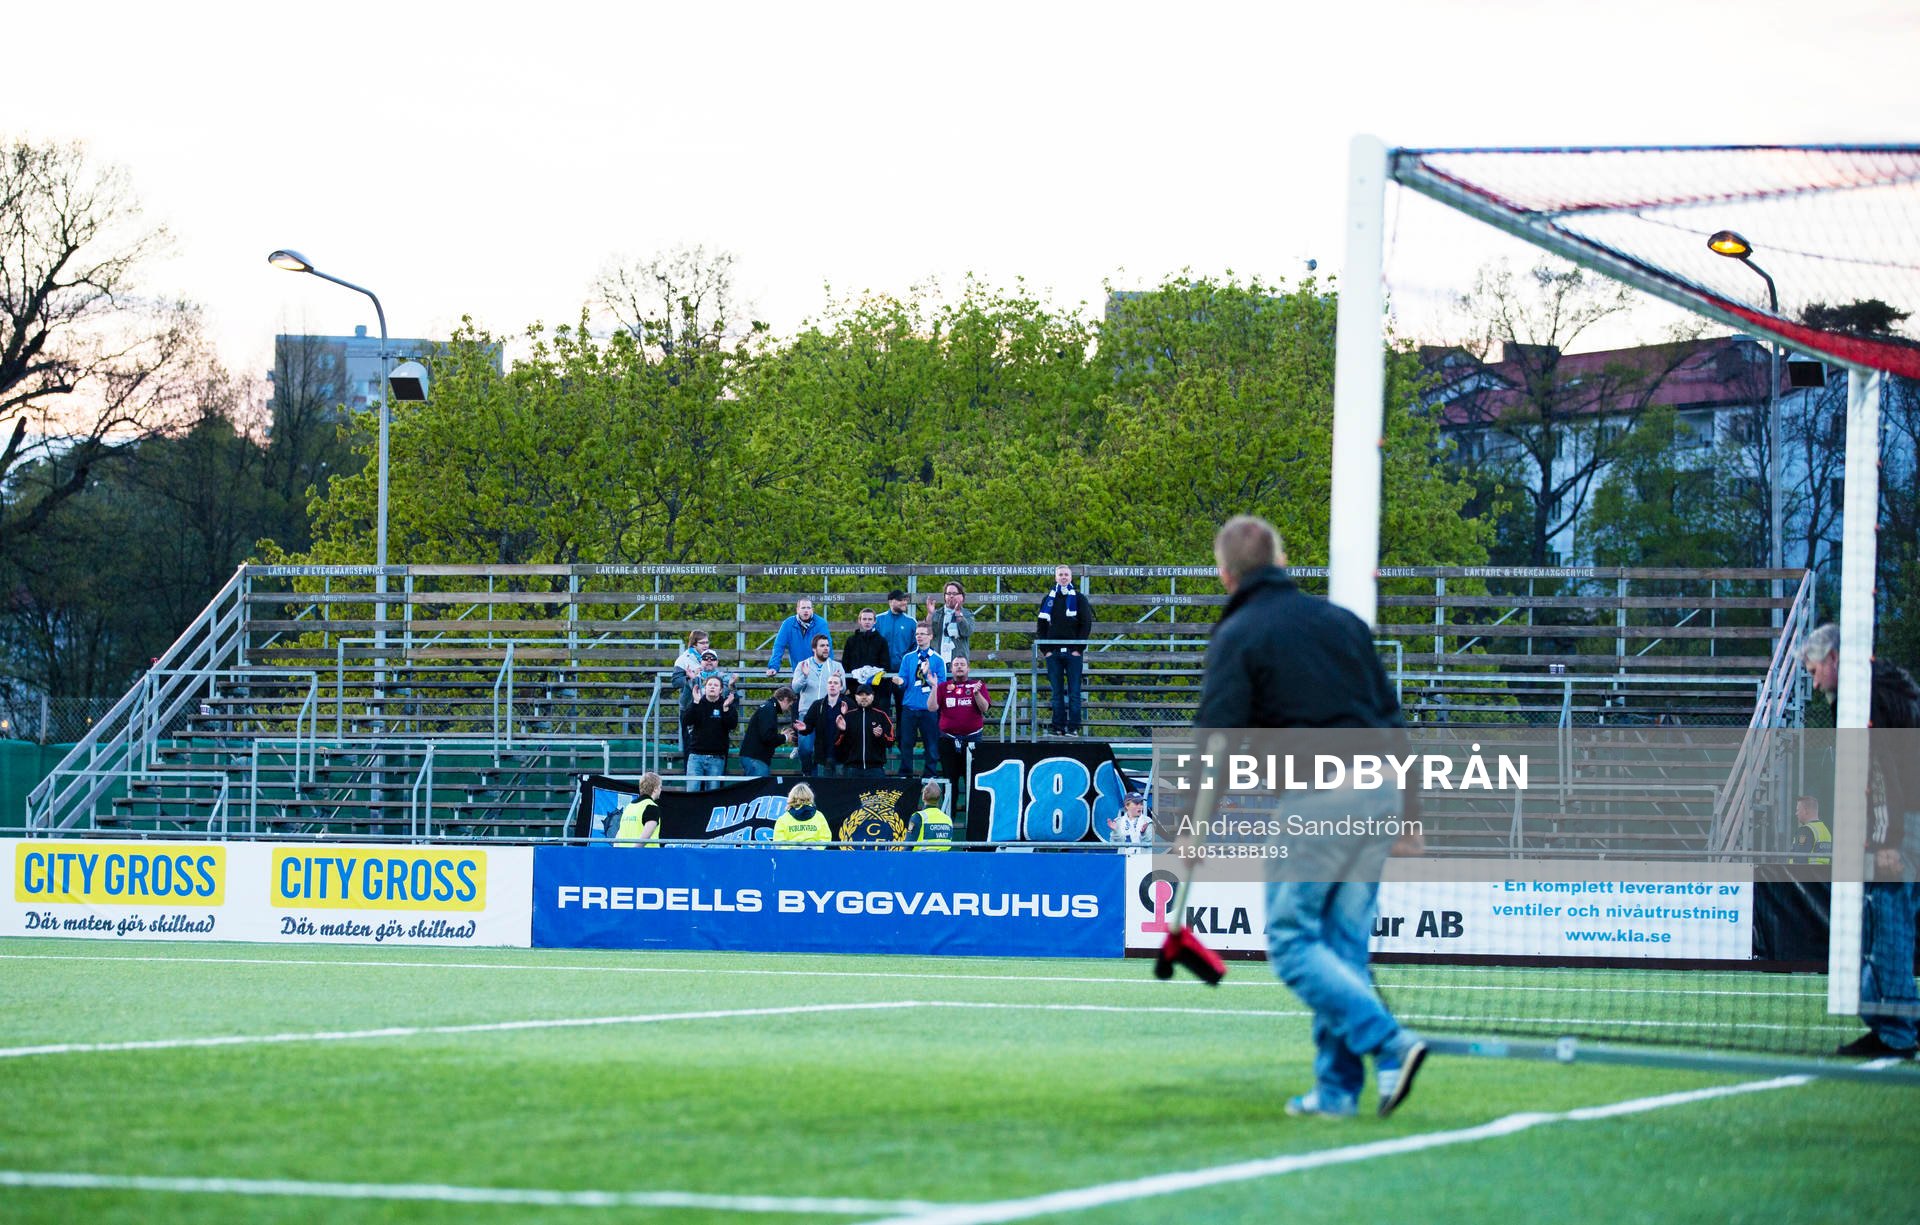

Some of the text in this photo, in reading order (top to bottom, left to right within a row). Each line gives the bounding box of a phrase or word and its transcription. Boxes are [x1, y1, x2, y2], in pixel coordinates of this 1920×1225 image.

[801, 567, 807, 575] &
[973, 567, 978, 575] &
[982, 567, 1056, 575] EVENEMANGSERVIC
[24, 852, 216, 897] CITY GROSS
[280, 856, 477, 902] CITY GROSS
[1504, 879, 1526, 892] En
[1532, 880, 1613, 896] komplett
[1619, 880, 1712, 896] leverantör
[1718, 884, 1740, 896] av
[558, 886, 1099, 918] FREDELLS BYGGVARUHUS
[1492, 903, 1739, 923] ventiler och nivåutrustning
[25, 911, 215, 936] Där maten gör skillnad
[280, 916, 476, 942] Där maten gör skillnad
[1185, 906, 1251, 934] KLA
[1416, 910, 1464, 938] AB
[1565, 929, 1671, 943] www.kla.se
